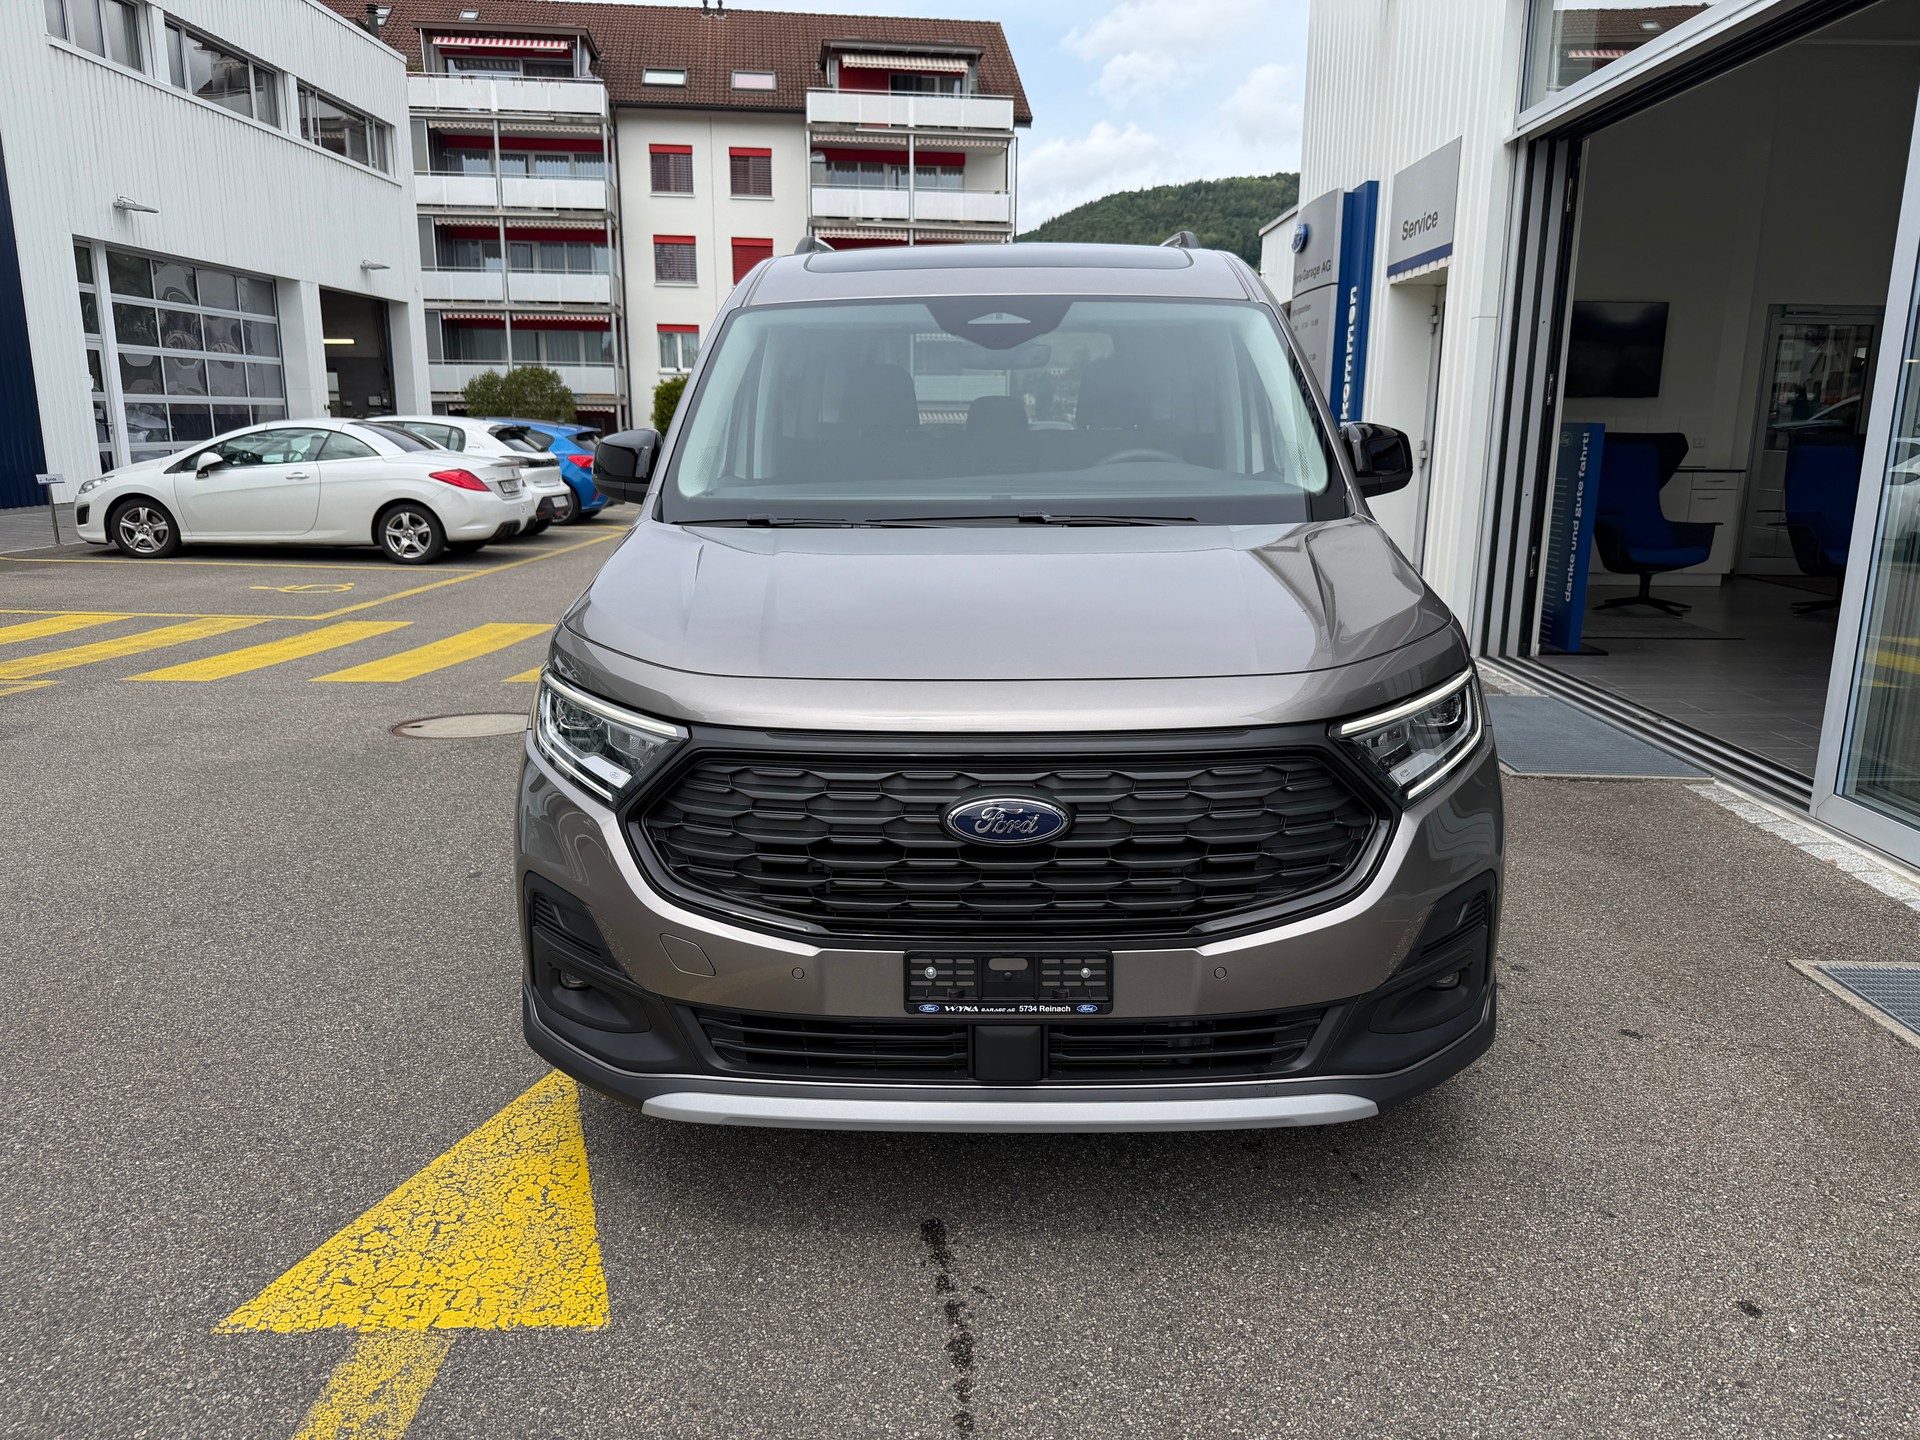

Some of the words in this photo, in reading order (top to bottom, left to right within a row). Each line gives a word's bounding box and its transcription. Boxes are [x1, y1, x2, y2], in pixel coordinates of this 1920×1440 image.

[1402, 211, 1438, 241] Service
[1321, 259, 1331, 274] AG
[1575, 481, 1584, 518] gute
[1571, 519, 1580, 551] und
[1565, 552, 1576, 602] danke
[974, 806, 1040, 834] Ford
[944, 1004, 979, 1012] WYNA
[1018, 1004, 1037, 1013] 5734
[1039, 1004, 1071, 1013] Reinach
